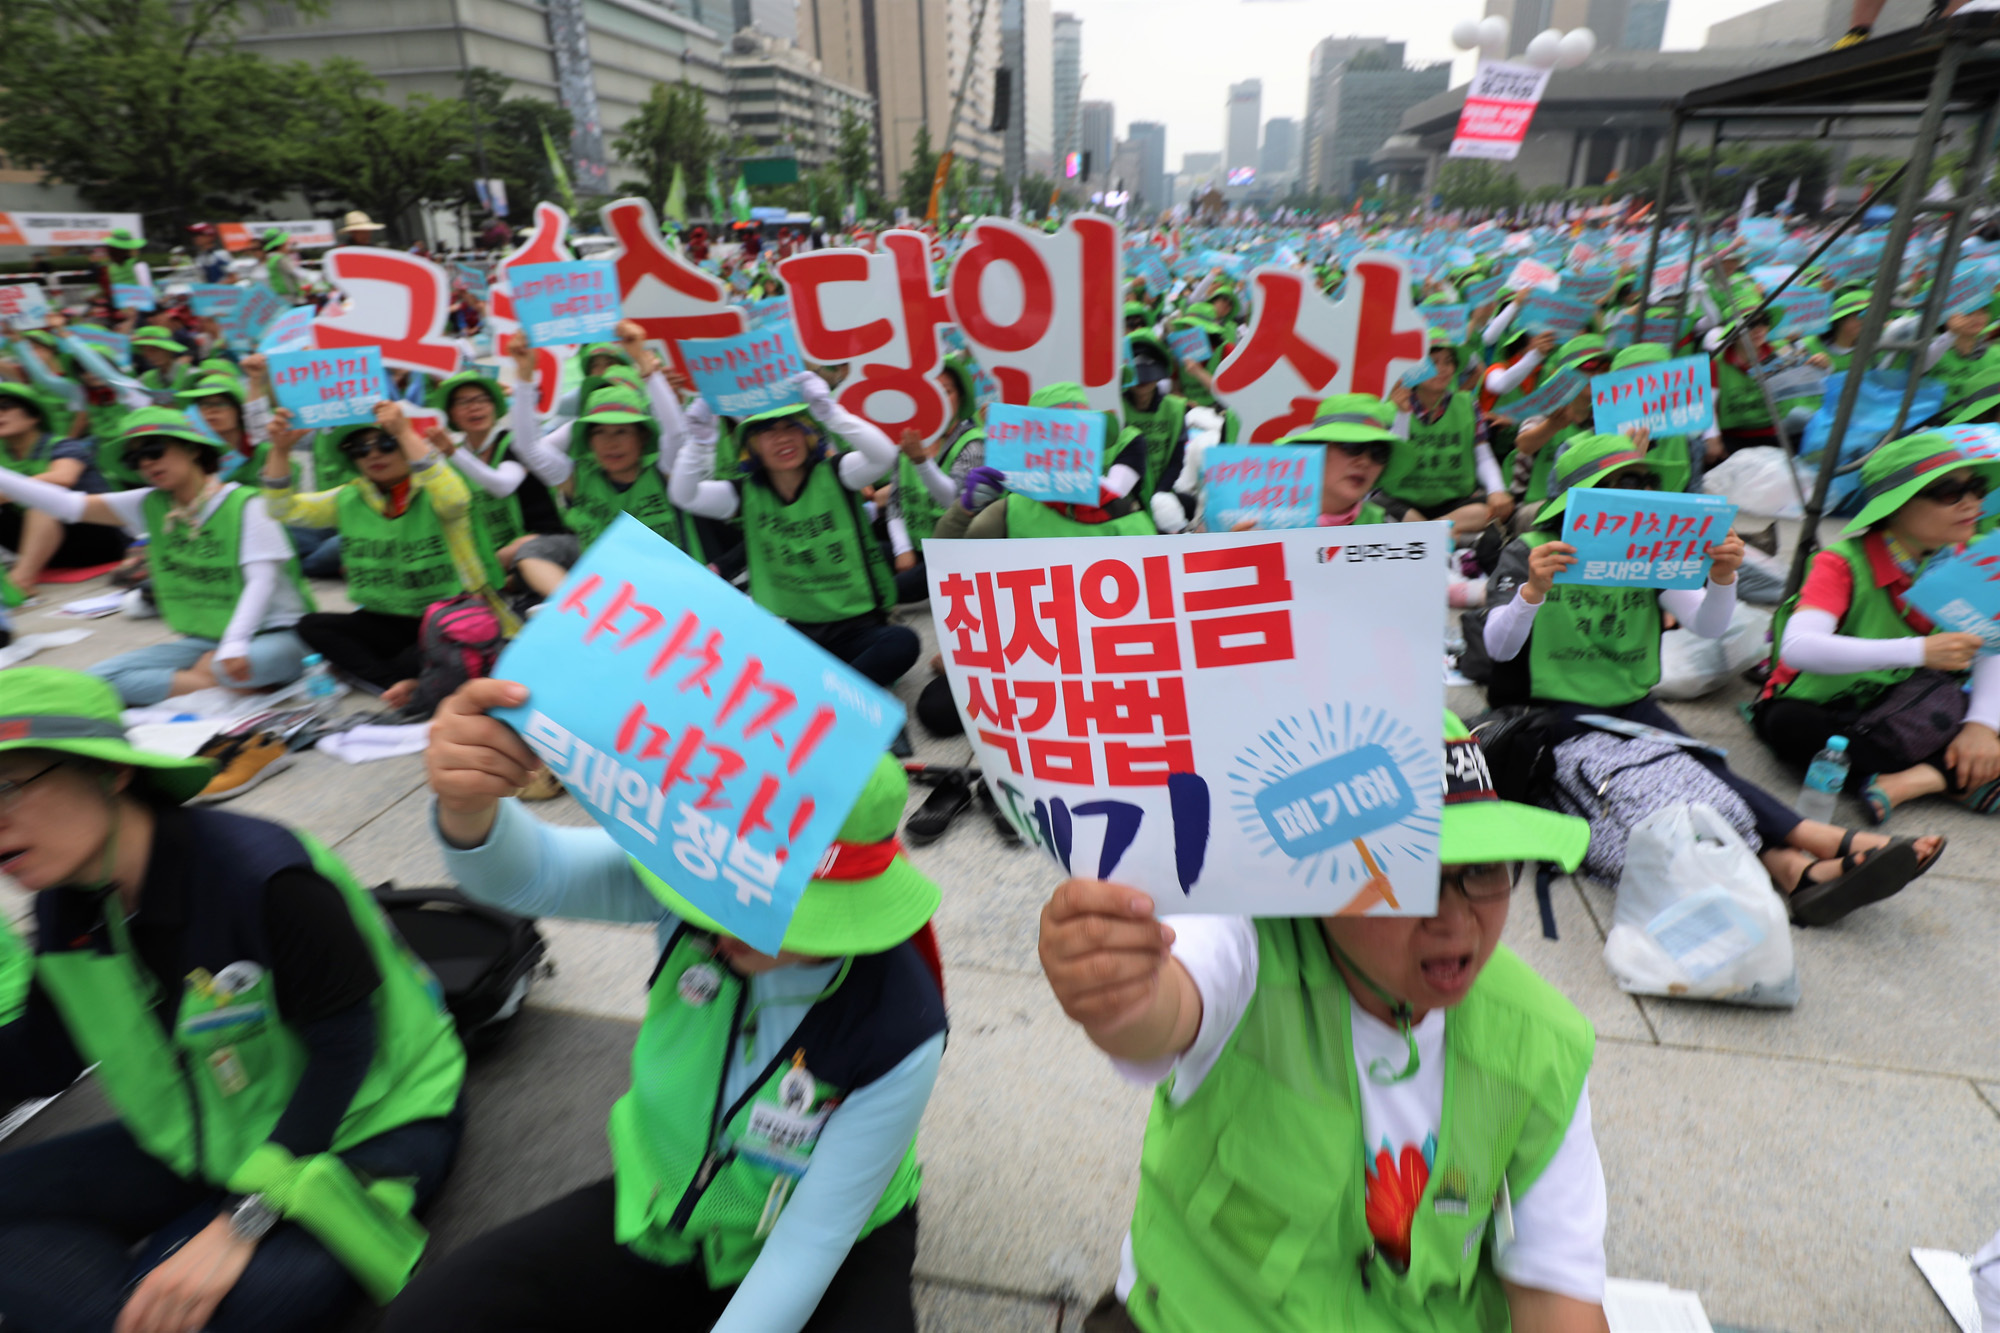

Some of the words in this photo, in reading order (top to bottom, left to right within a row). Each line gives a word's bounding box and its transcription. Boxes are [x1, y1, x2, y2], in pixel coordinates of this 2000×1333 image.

[1344, 541, 1428, 563] 민주노총
[1573, 511, 1714, 538] 사기치지
[1583, 560, 1652, 580] 문재인
[1655, 559, 1703, 580] 정부
[940, 542, 1295, 675] 최저임금
[556, 572, 836, 777] 사기치지
[967, 676, 1195, 788] 삭감법
[523, 708, 668, 846] 문재인
[670, 802, 786, 907] 정부
[996, 770, 1210, 898] 폐기
[1271, 765, 1401, 843] 폐기해
